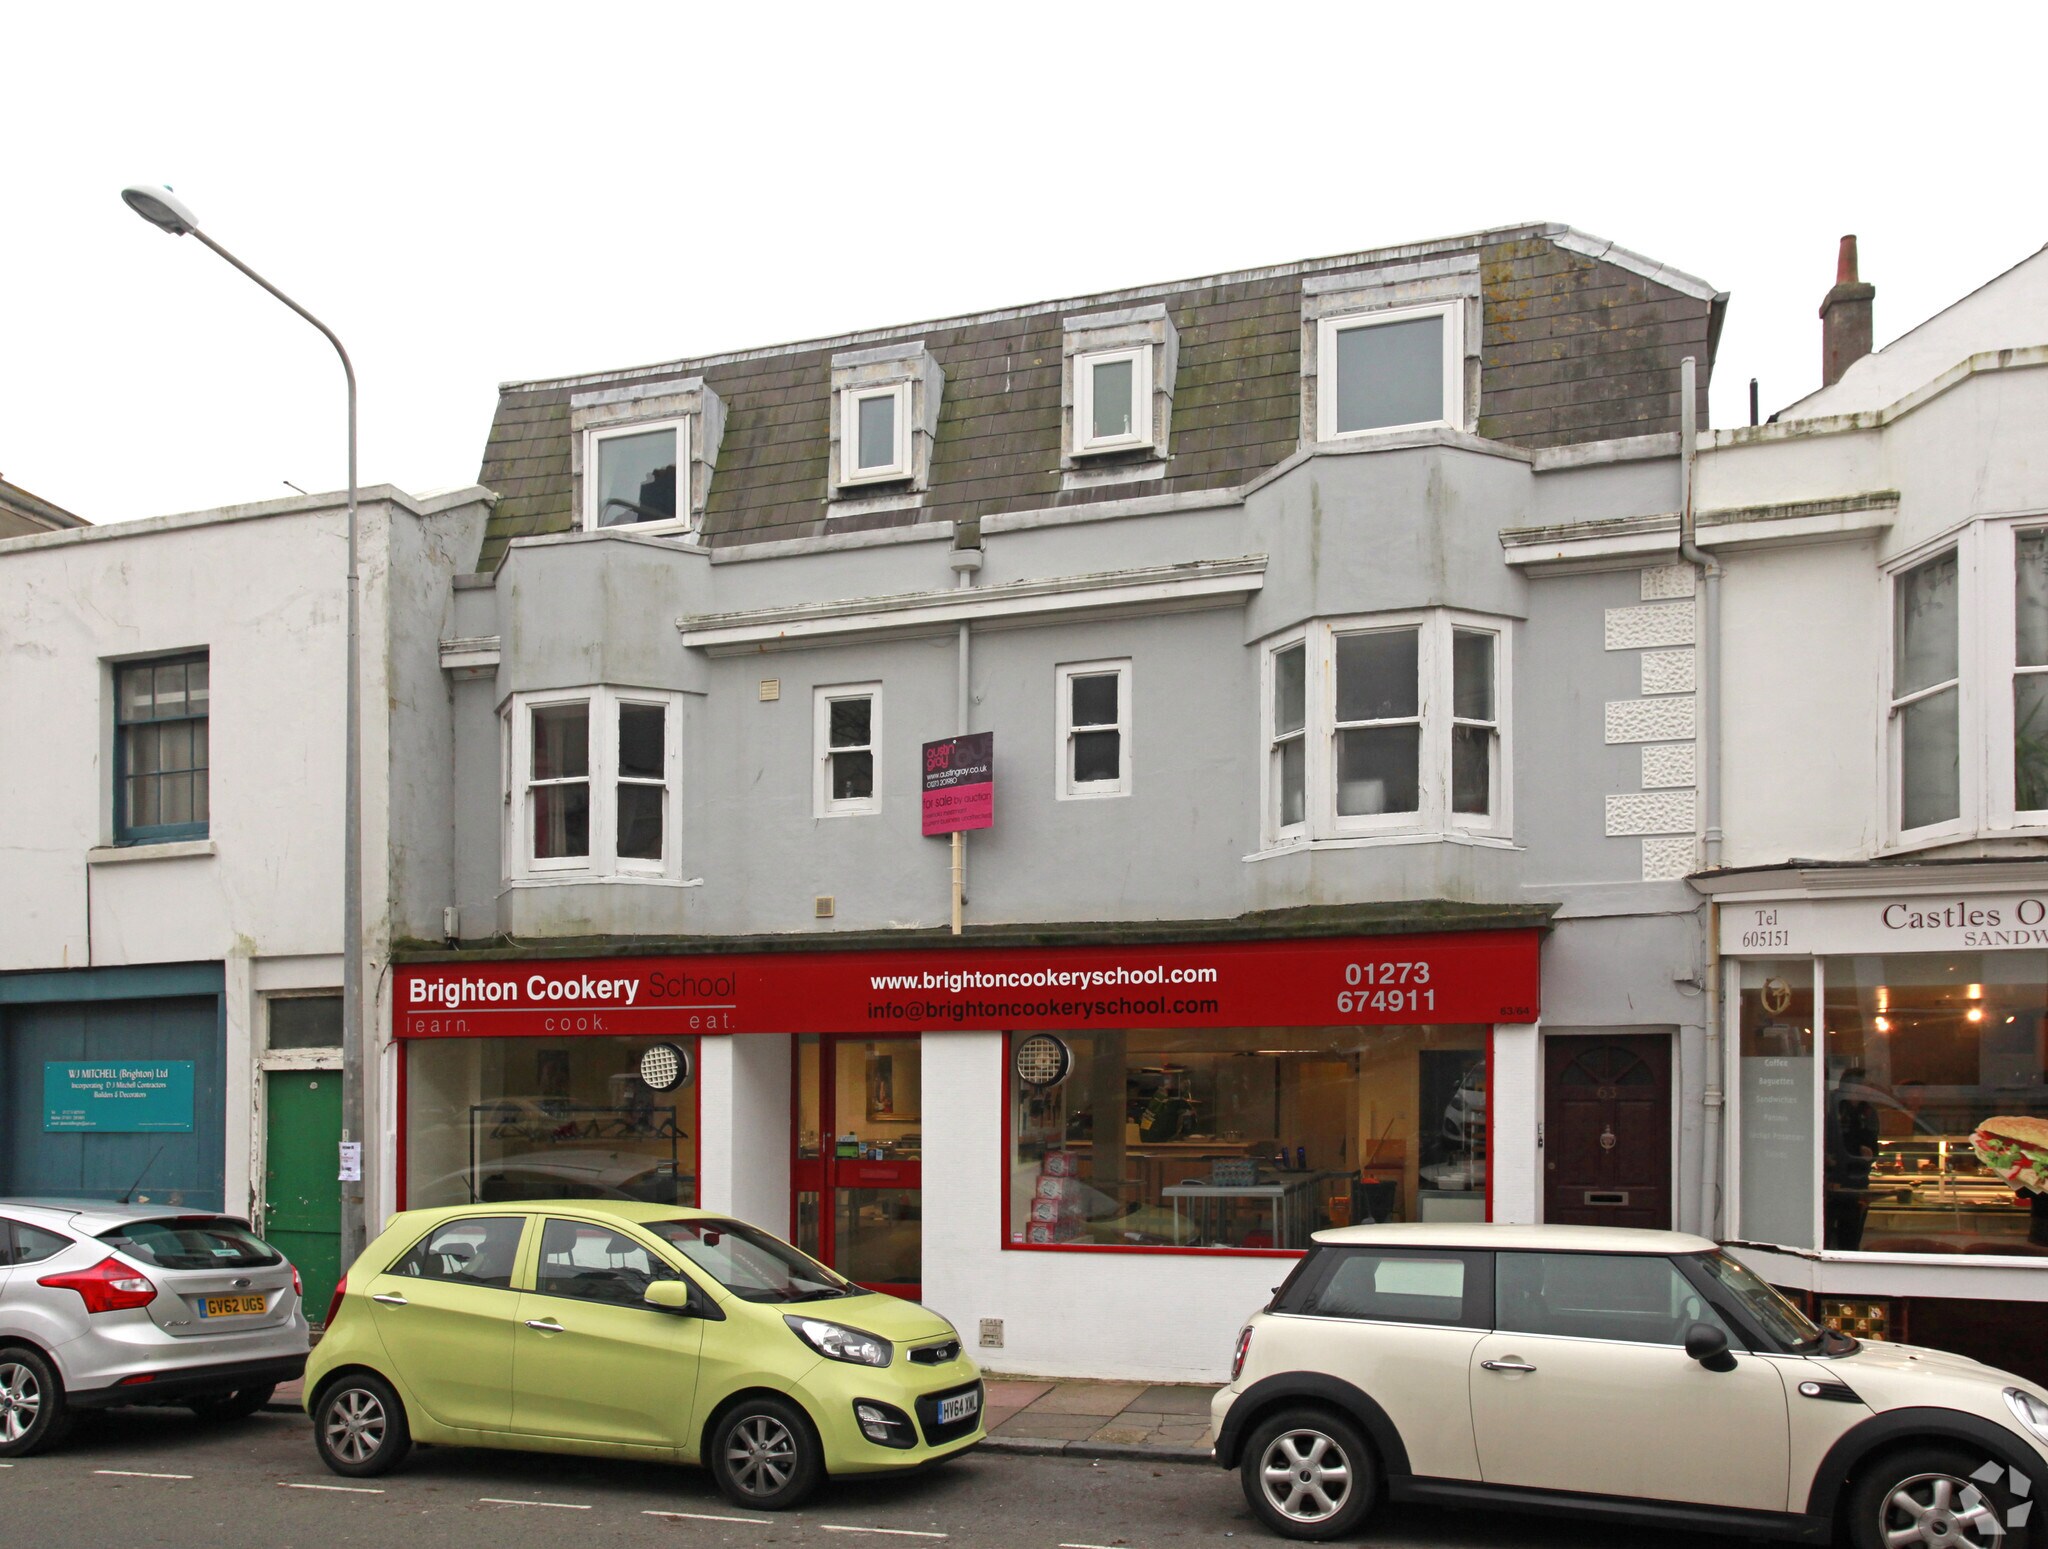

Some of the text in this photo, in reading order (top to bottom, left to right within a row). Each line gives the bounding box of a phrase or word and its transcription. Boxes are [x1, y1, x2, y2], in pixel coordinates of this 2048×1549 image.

[927, 744, 955, 758] austin
[926, 764, 988, 780] www.austingray.co.uk
[927, 756, 949, 772] gray
[936, 795, 953, 808] sale
[964, 793, 992, 804] auction
[1755, 909, 1778, 926] Tel
[1881, 901, 2001, 930] Castles
[1742, 930, 1789, 947] 605151
[870, 965, 1218, 993] www.brightoncookeryschool.com
[1345, 961, 1430, 986] 01273
[409, 972, 736, 1008] Brighton Cookery School
[867, 995, 1219, 1023] info@brightoncookeryschool.com
[1337, 989, 1435, 1013] 674911
[407, 1012, 736, 1033] learn. cook. eat.
[1764, 1059, 1788, 1067] Coffee
[81, 1069, 117, 1079] MITCHELL
[119, 1068, 154, 1080] (Brighton)
[156, 1068, 168, 1078] Ltd
[1759, 1077, 1794, 1087] Baguettes
[71, 1081, 103, 1090] Incorporating
[1597, 1086, 1617, 1099] 63
[94, 1091, 113, 1099] Builders
[1756, 1095, 1797, 1103] Sandwiches
[208, 1297, 264, 1314] GV62 UGS
[943, 1398, 963, 1420] HV64
